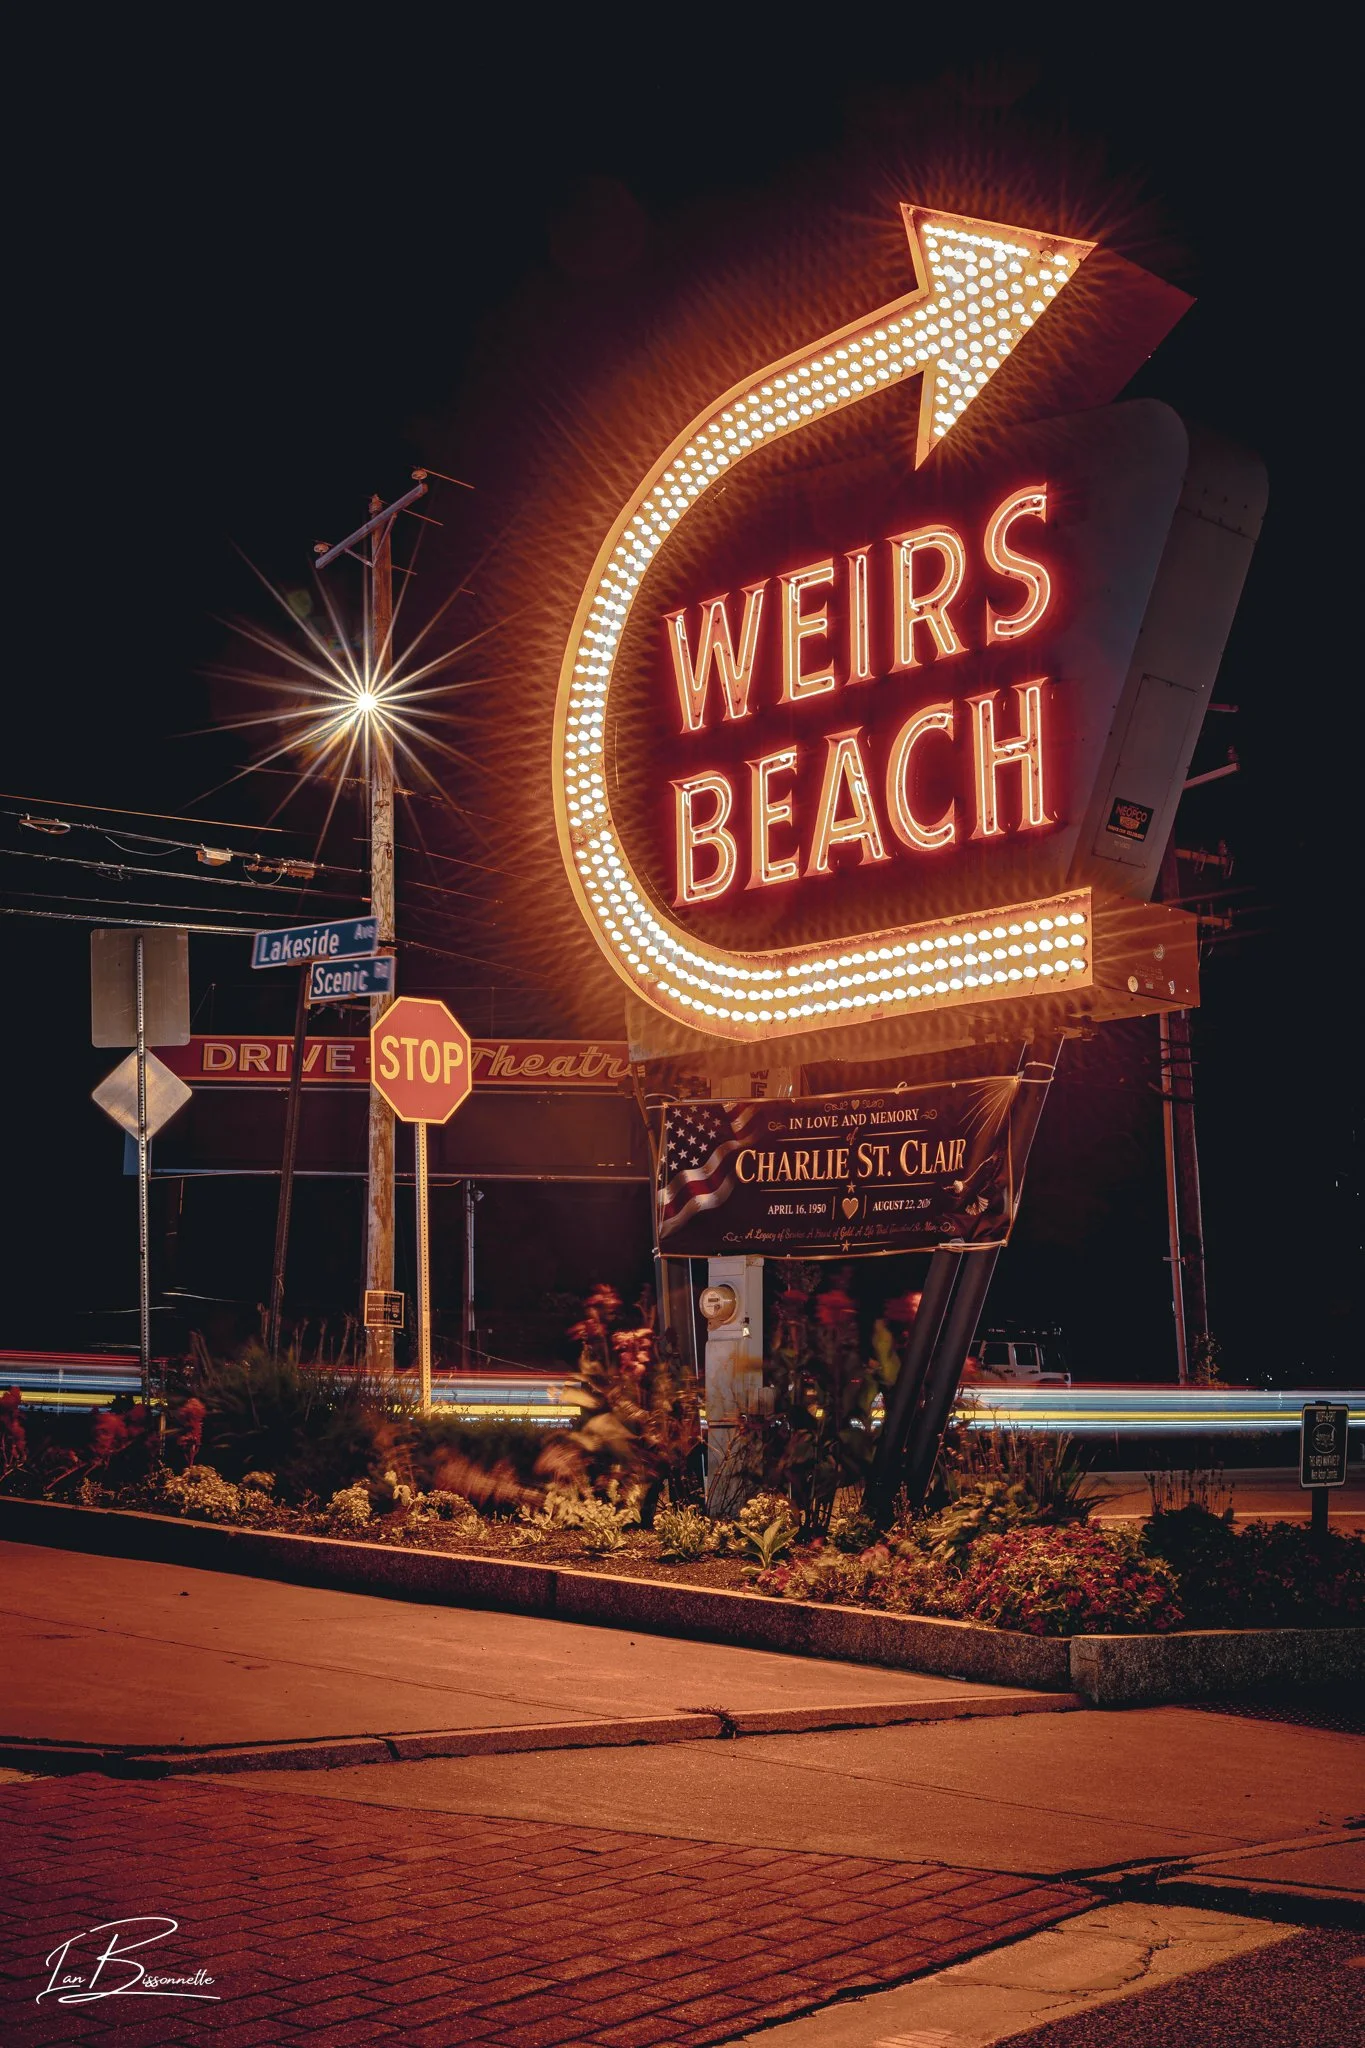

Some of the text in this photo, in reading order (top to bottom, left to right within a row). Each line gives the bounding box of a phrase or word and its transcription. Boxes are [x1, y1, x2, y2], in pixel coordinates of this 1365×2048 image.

[662, 482, 1051, 735] WEIRS
[669, 677, 1055, 908] BEACH
[259, 923, 376, 962] Lakeside Ave
[313, 963, 369, 995] Scenic
[380, 1036, 463, 1085] STOP
[789, 1109, 920, 1130] IN LOVE AND MEMORY
[846, 1127, 859, 1146] of
[735, 1138, 967, 1183] CHARLIE ST. CLAIR
[768, 1204, 793, 1215] APRIL
[808, 1203, 827, 1214] 1950
[872, 1200, 905, 1212] AUGUST
